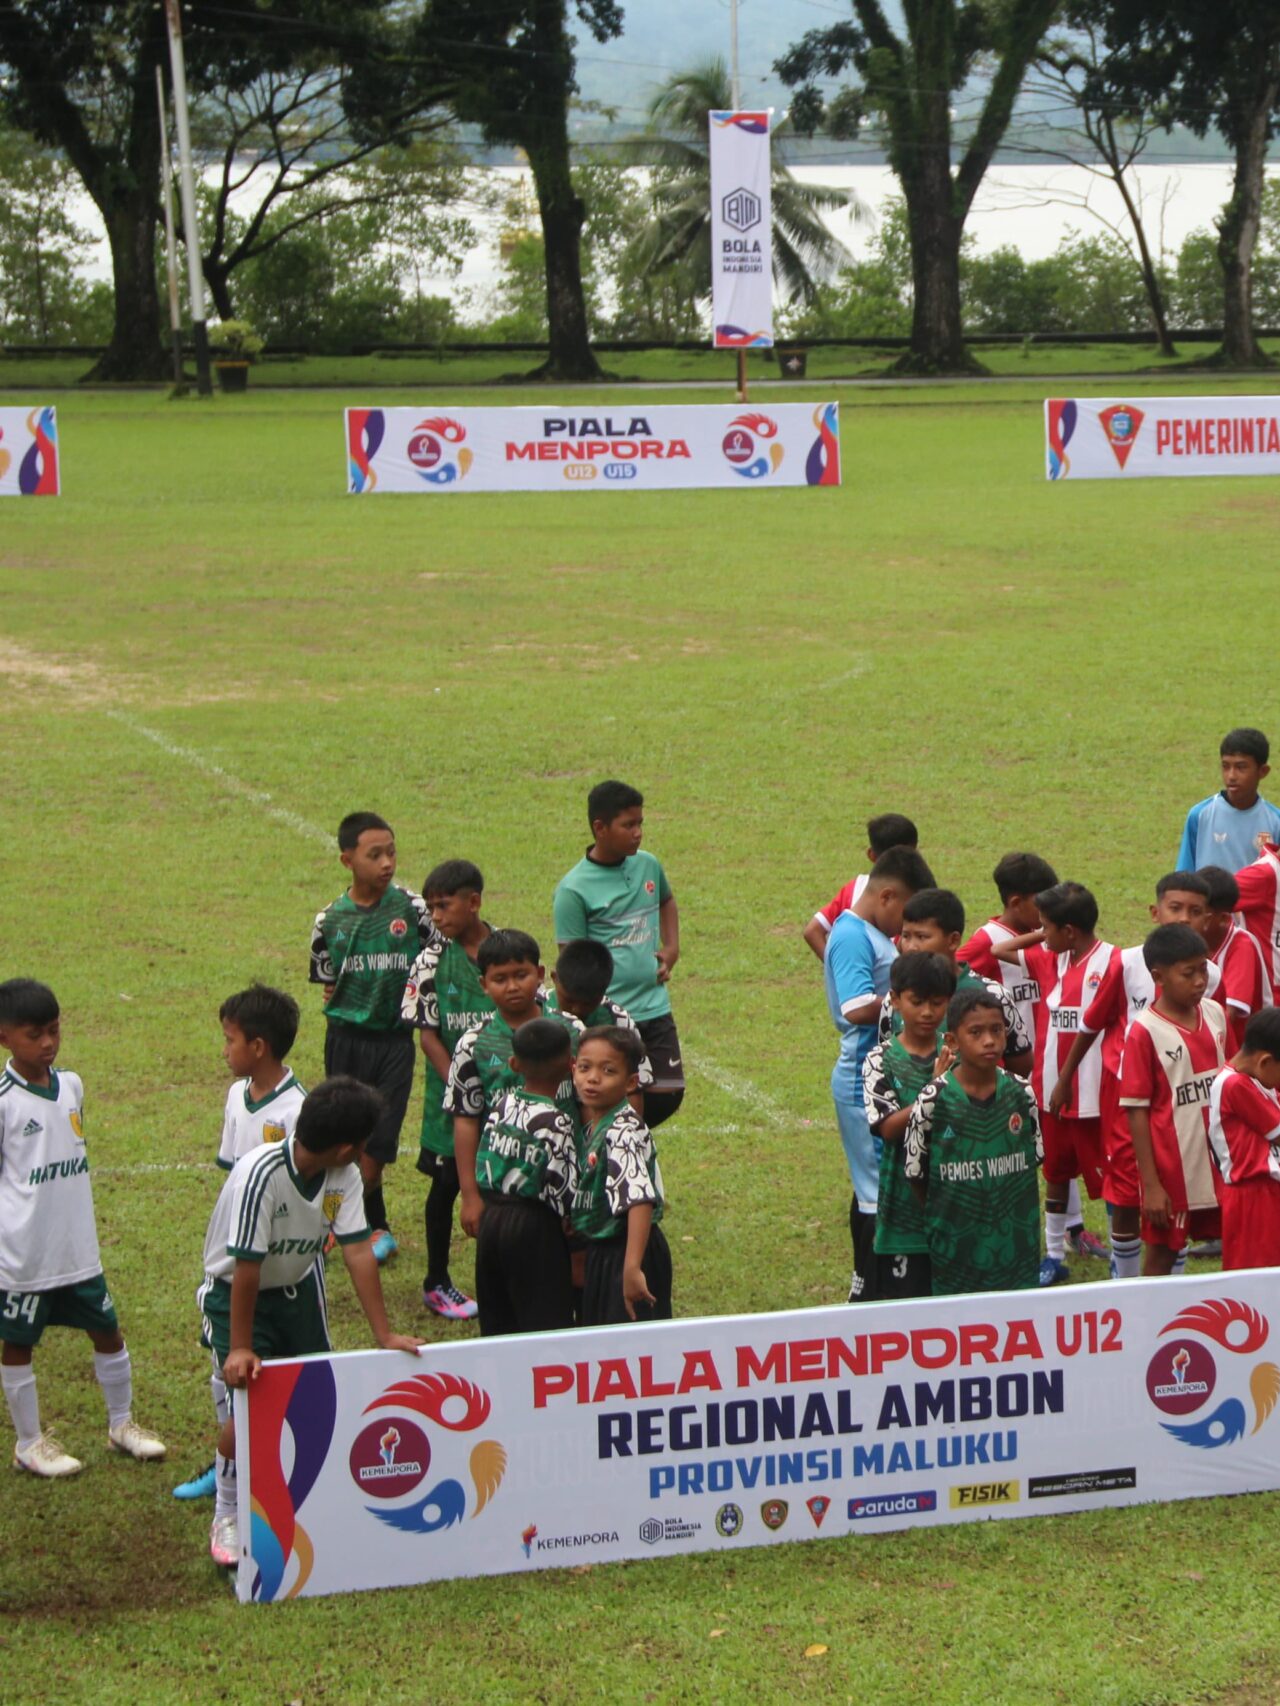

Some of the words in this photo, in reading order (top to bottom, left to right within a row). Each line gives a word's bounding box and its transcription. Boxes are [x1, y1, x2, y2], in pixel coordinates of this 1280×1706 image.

[722, 239, 761, 253] BOLA
[722, 264, 763, 273] MANDIRI
[543, 417, 653, 437] PIALA
[505, 438, 692, 461] MENPORA
[567, 465, 593, 479] U12
[607, 464, 634, 478] U15
[939, 1160, 984, 1182] PEMDES
[892, 1254, 908, 1278] 3
[2, 1290, 40, 1325] 54
[531, 1349, 723, 1409] PIALA
[736, 1318, 1044, 1388] MENPORA
[1055, 1308, 1123, 1358] U12
[1156, 1382, 1207, 1395] KEMENPORA
[597, 1386, 864, 1460] REGIONAL
[876, 1368, 1065, 1431] AMBON
[361, 1463, 420, 1478] KEMENPORA
[648, 1447, 844, 1499] PROVINSI
[852, 1430, 1018, 1478] MALUKU
[1095, 1476, 1134, 1486] META
[957, 1482, 1012, 1505] FISIK
[664, 1517, 683, 1525] BOLA
[664, 1522, 702, 1533] INDONESIA
[536, 1530, 620, 1551] KEMENPORA
[664, 1531, 695, 1540] MANDIRI
